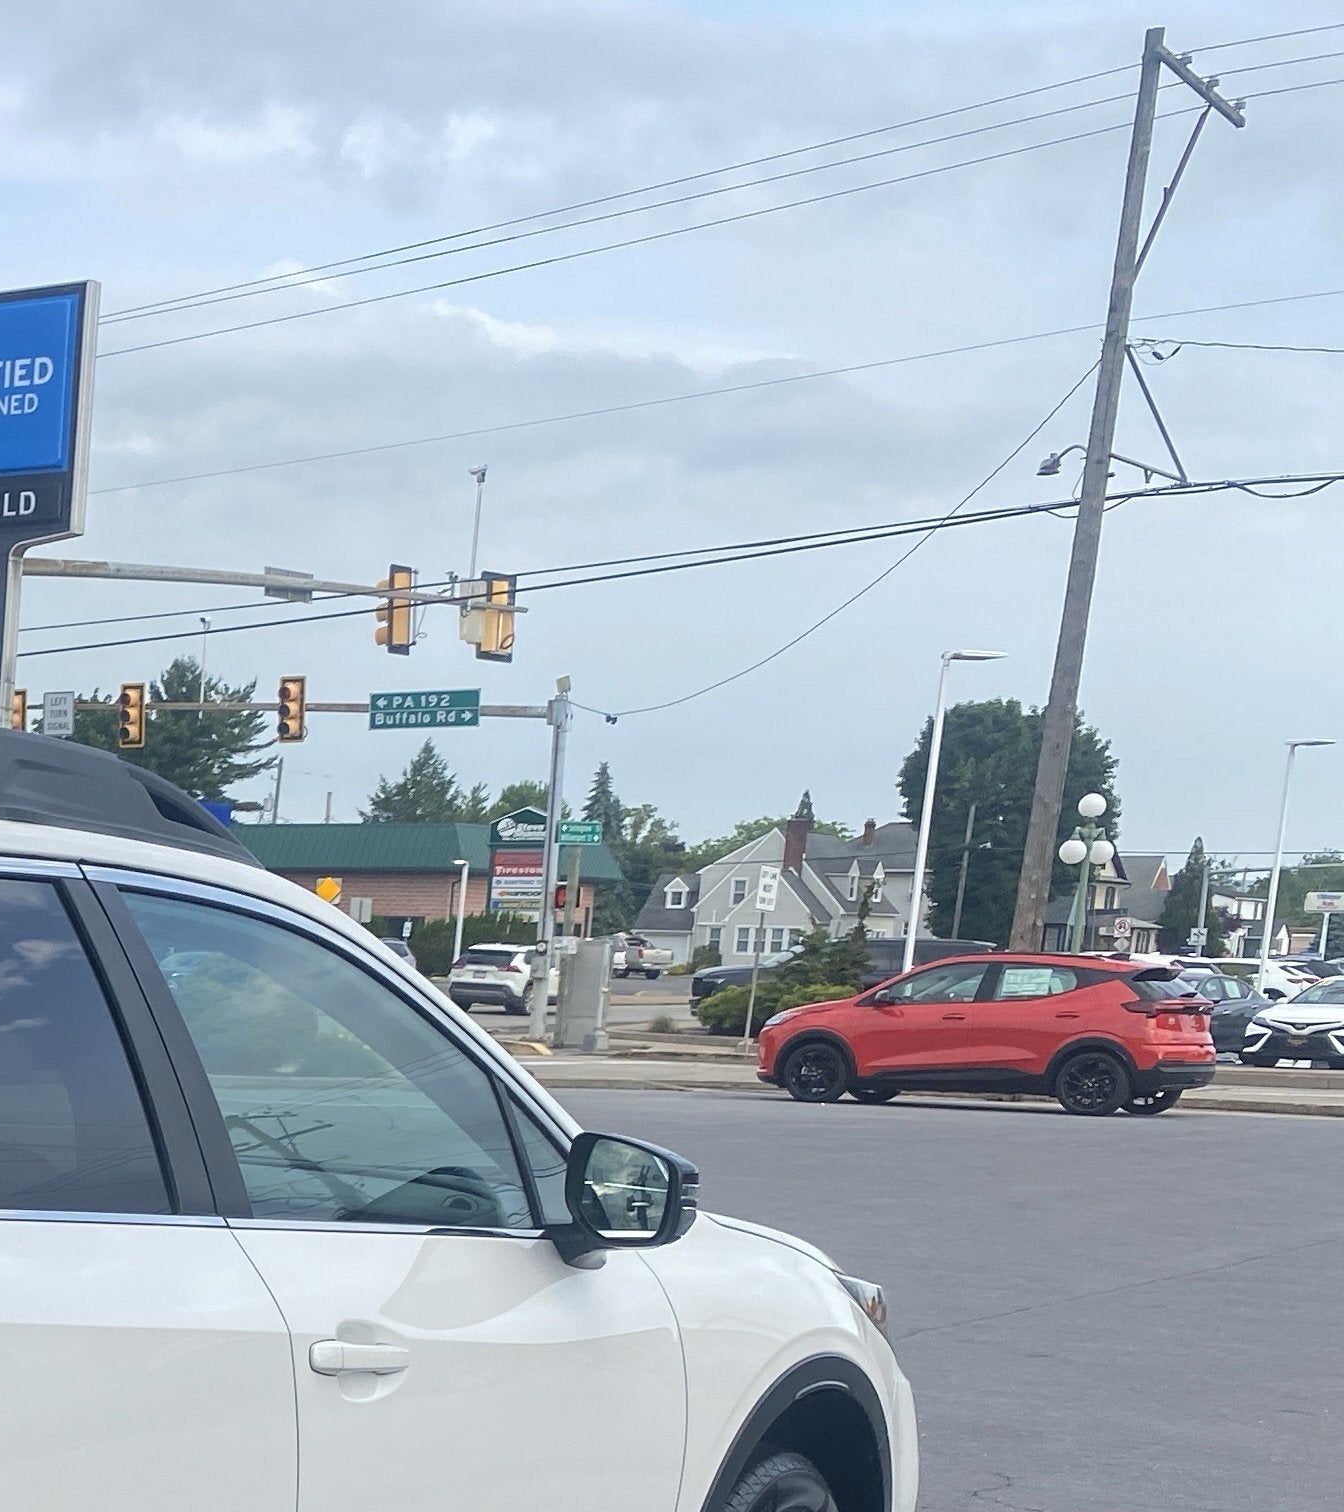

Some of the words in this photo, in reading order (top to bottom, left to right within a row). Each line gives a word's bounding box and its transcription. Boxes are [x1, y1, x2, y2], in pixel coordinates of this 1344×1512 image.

[392, 695, 415, 708] PA
[420, 694, 450, 708] 192
[375, 711, 431, 725] Buffalo
[436, 710, 456, 723] Rd
[495, 866, 545, 876] Fireston
